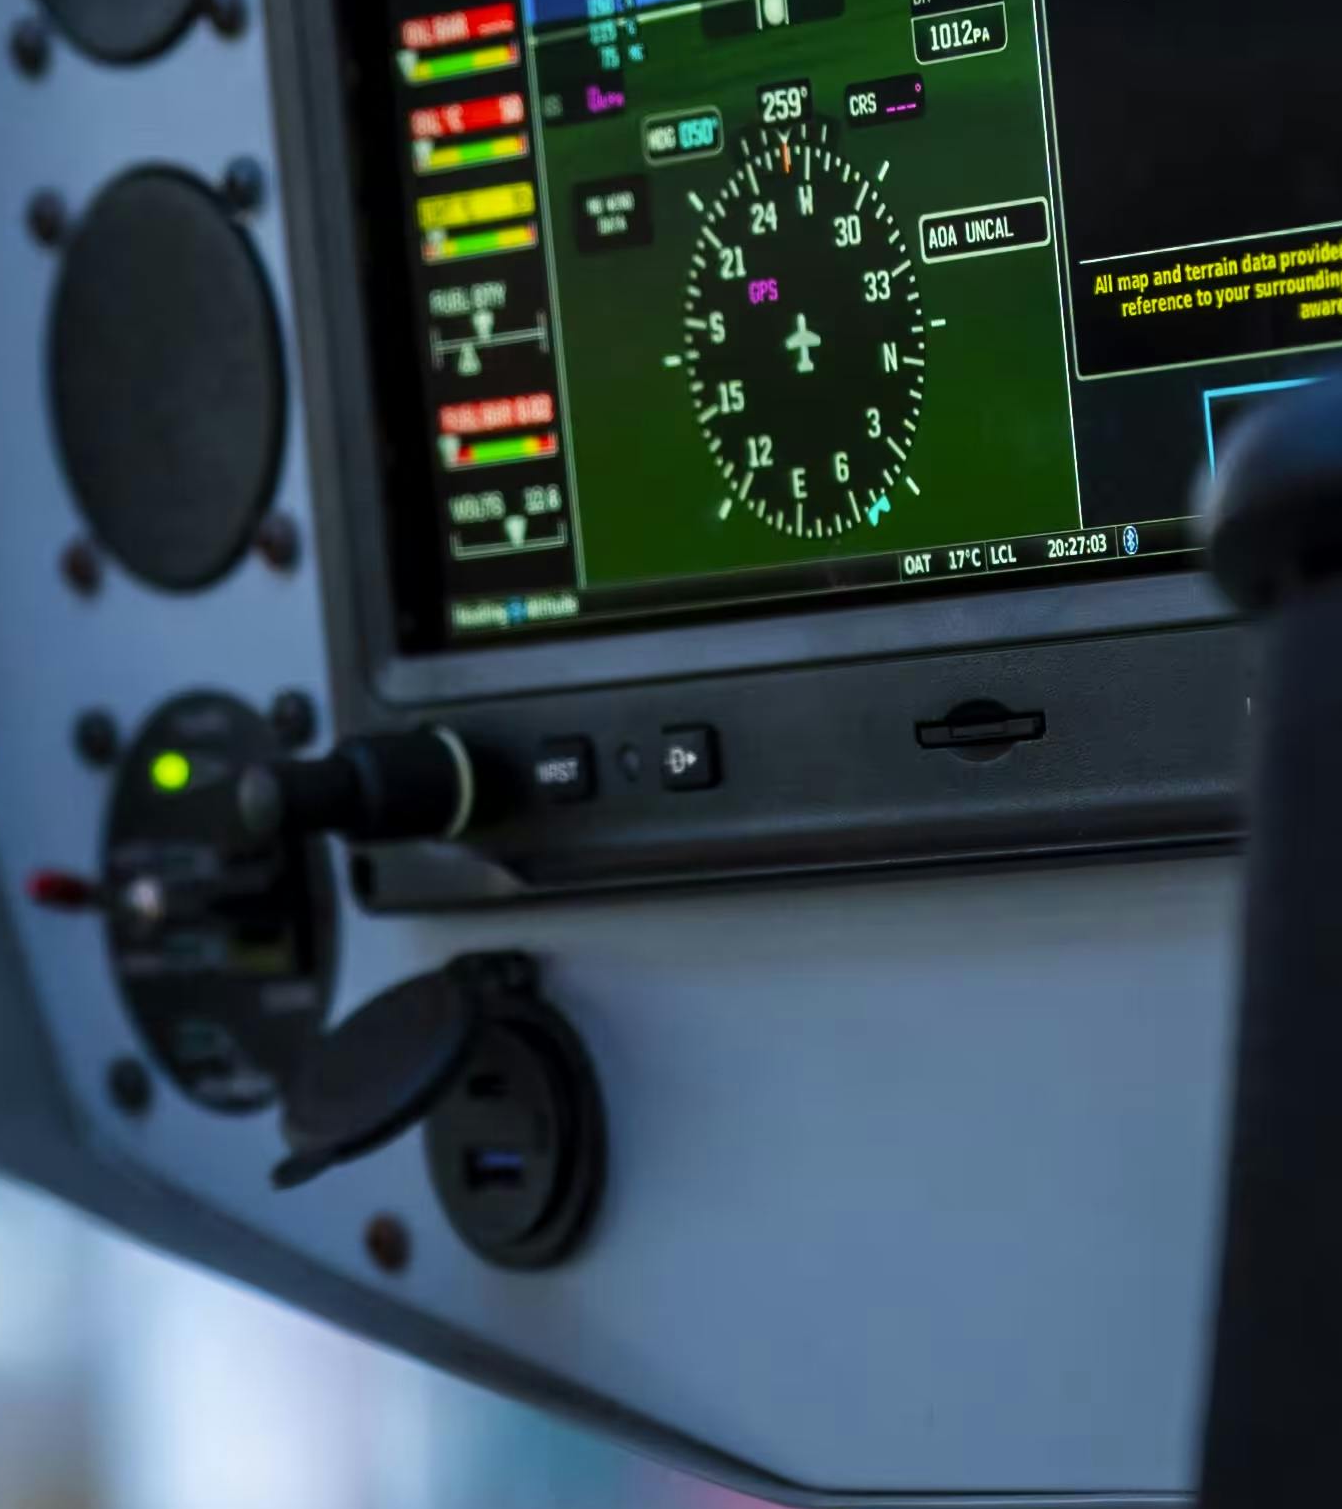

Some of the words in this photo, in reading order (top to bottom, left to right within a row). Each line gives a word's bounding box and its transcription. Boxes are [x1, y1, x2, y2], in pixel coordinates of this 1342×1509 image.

[761, 86, 808, 123] 259°
[849, 92, 878, 117] CRS
[798, 184, 813, 216] W
[750, 200, 778, 235] 24
[833, 214, 862, 248] 30
[929, 224, 958, 249] AOA
[965, 215, 1015, 243] UNCAL
[719, 245, 747, 279] 21
[1094, 274, 1113, 295] All
[1117, 273, 1149, 292] map
[1153, 264, 1182, 286] and
[1185, 257, 1238, 282] terrain
[1242, 252, 1277, 274] data
[748, 277, 779, 305] GPS
[863, 270, 891, 302] 33
[1121, 292, 1193, 317] reference
[1196, 289, 1213, 307] to
[1216, 286, 1251, 308] your
[709, 310, 726, 343] S
[882, 342, 898, 373] N
[718, 380, 745, 413] 15
[866, 407, 881, 438] 3
[748, 434, 774, 468] 12
[834, 451, 850, 482] 6
[792, 467, 807, 499] E
[903, 553, 931, 575] OAT
[947, 547, 982, 570] 17°C
[990, 544, 1017, 565] LCL
[1046, 533, 1108, 558] 20:27:03
